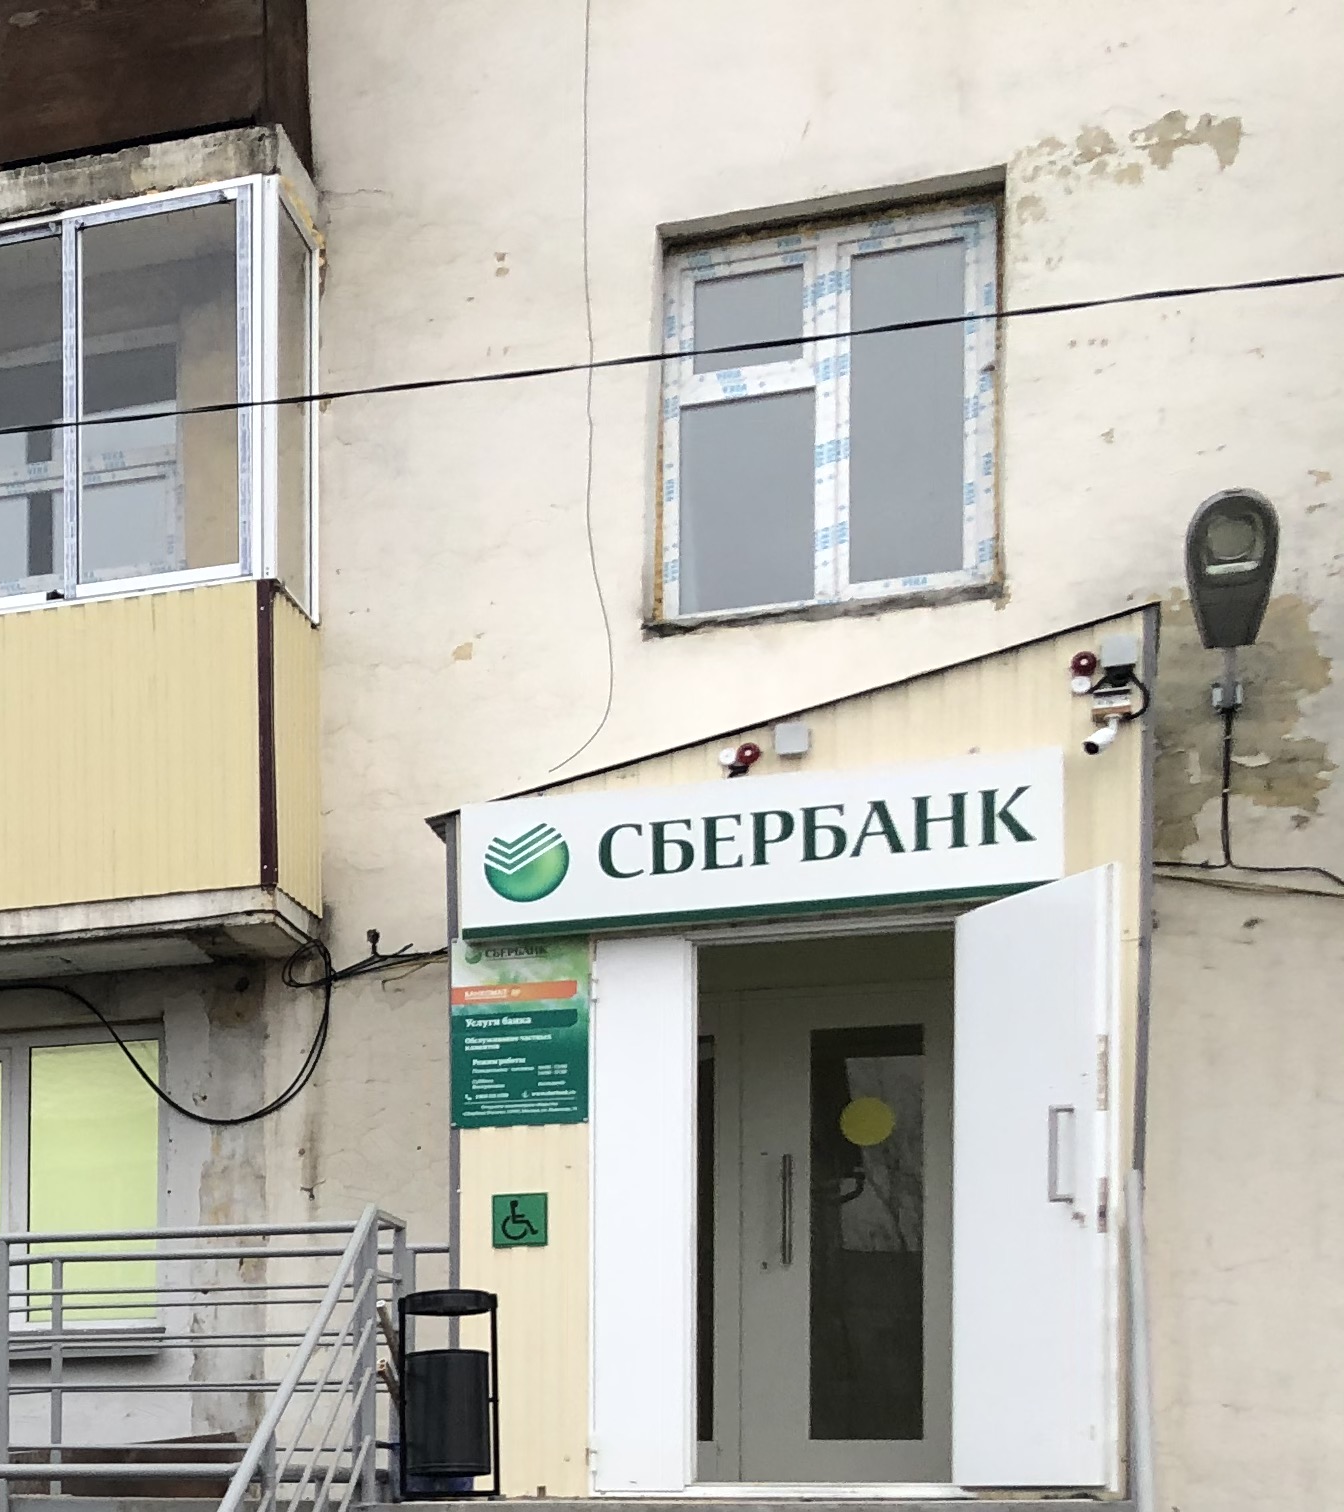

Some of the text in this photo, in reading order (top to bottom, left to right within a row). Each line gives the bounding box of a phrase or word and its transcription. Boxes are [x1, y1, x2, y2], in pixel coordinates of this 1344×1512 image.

[598, 785, 1037, 879] СБЕРБАНК
[465, 1015, 532, 1029] Услуги банка
